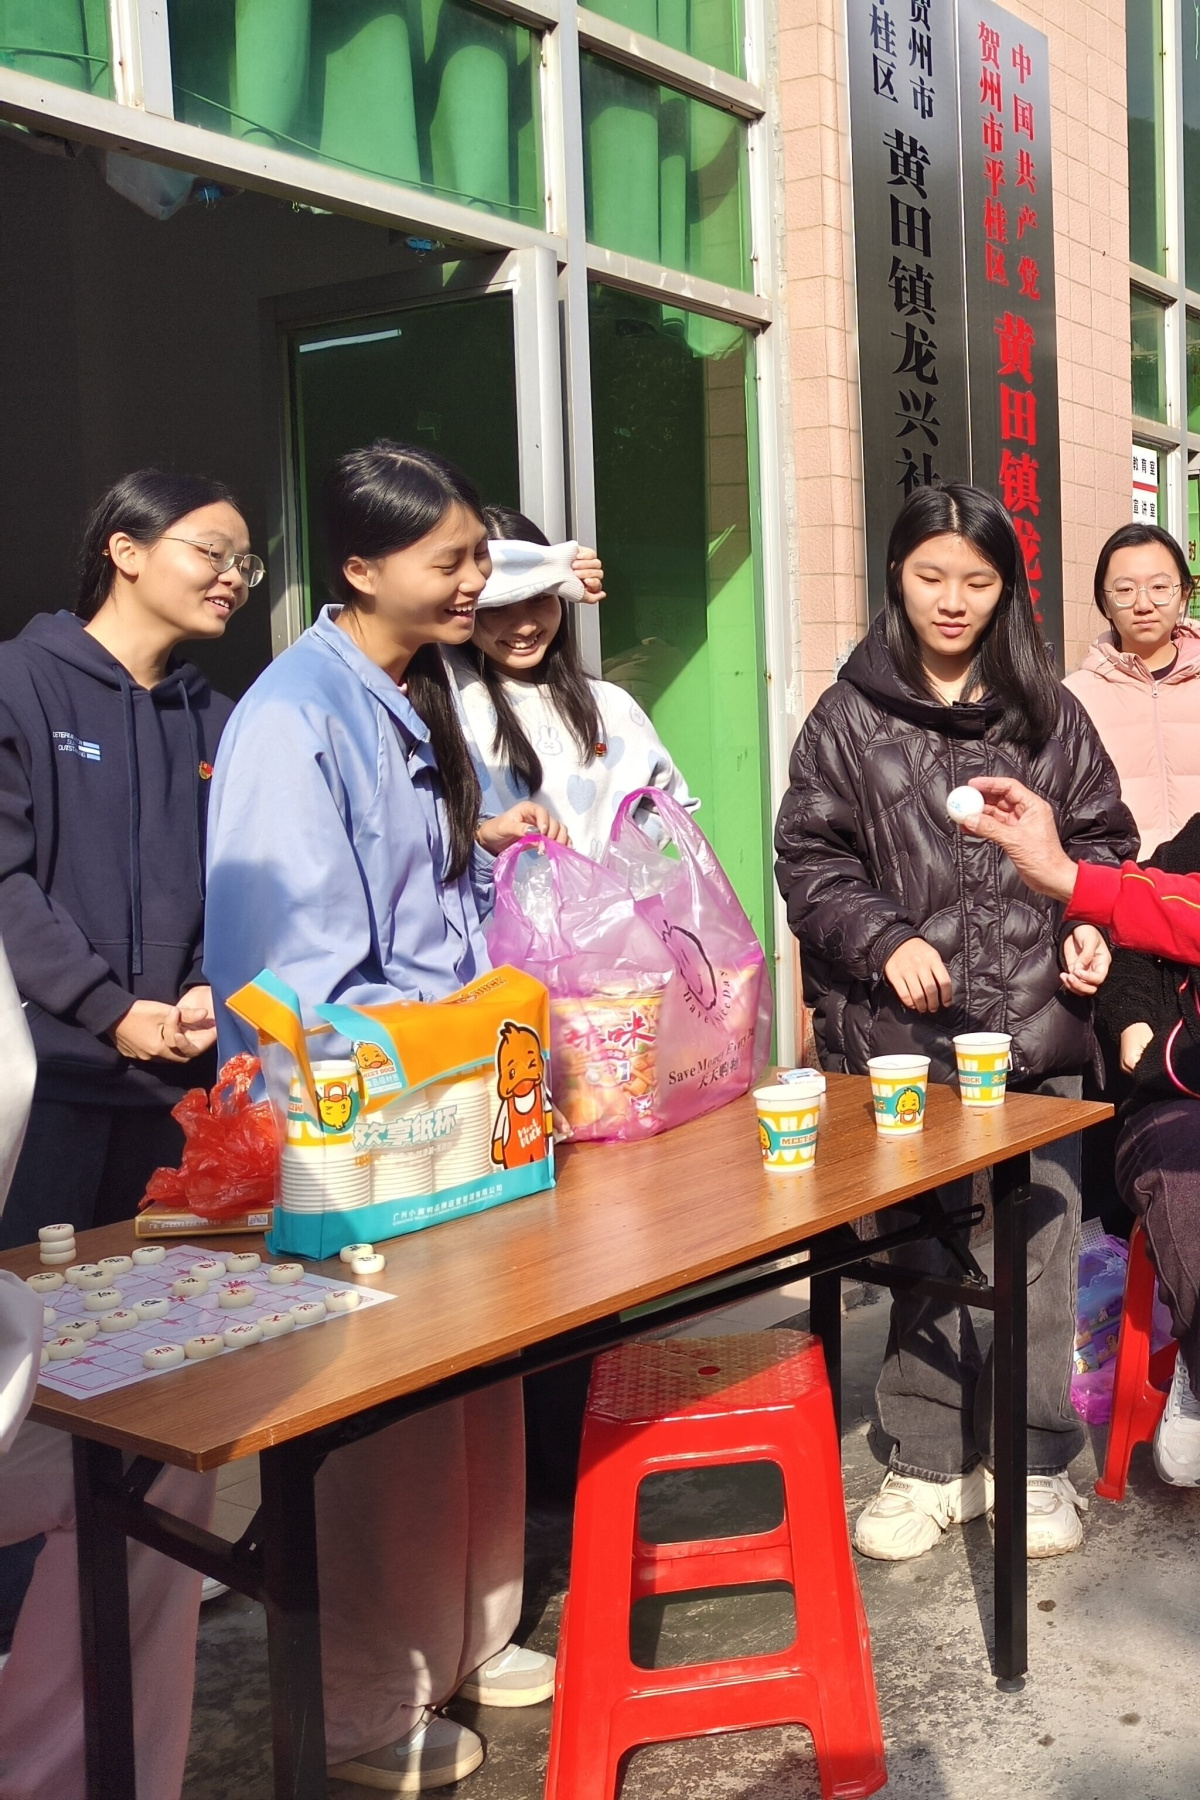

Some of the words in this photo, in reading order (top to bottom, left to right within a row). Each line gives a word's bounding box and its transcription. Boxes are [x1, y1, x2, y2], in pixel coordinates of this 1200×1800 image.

[869, 0, 898, 103] 桂区
[977, 20, 1009, 287] 贺州市平桂区
[1011, 43, 1040, 300] 中国共产党
[995, 311, 1044, 623] 黄田镇龙
[353, 1105, 457, 1149] 欢享纸杯
[669, 1066, 696, 1085] Save
